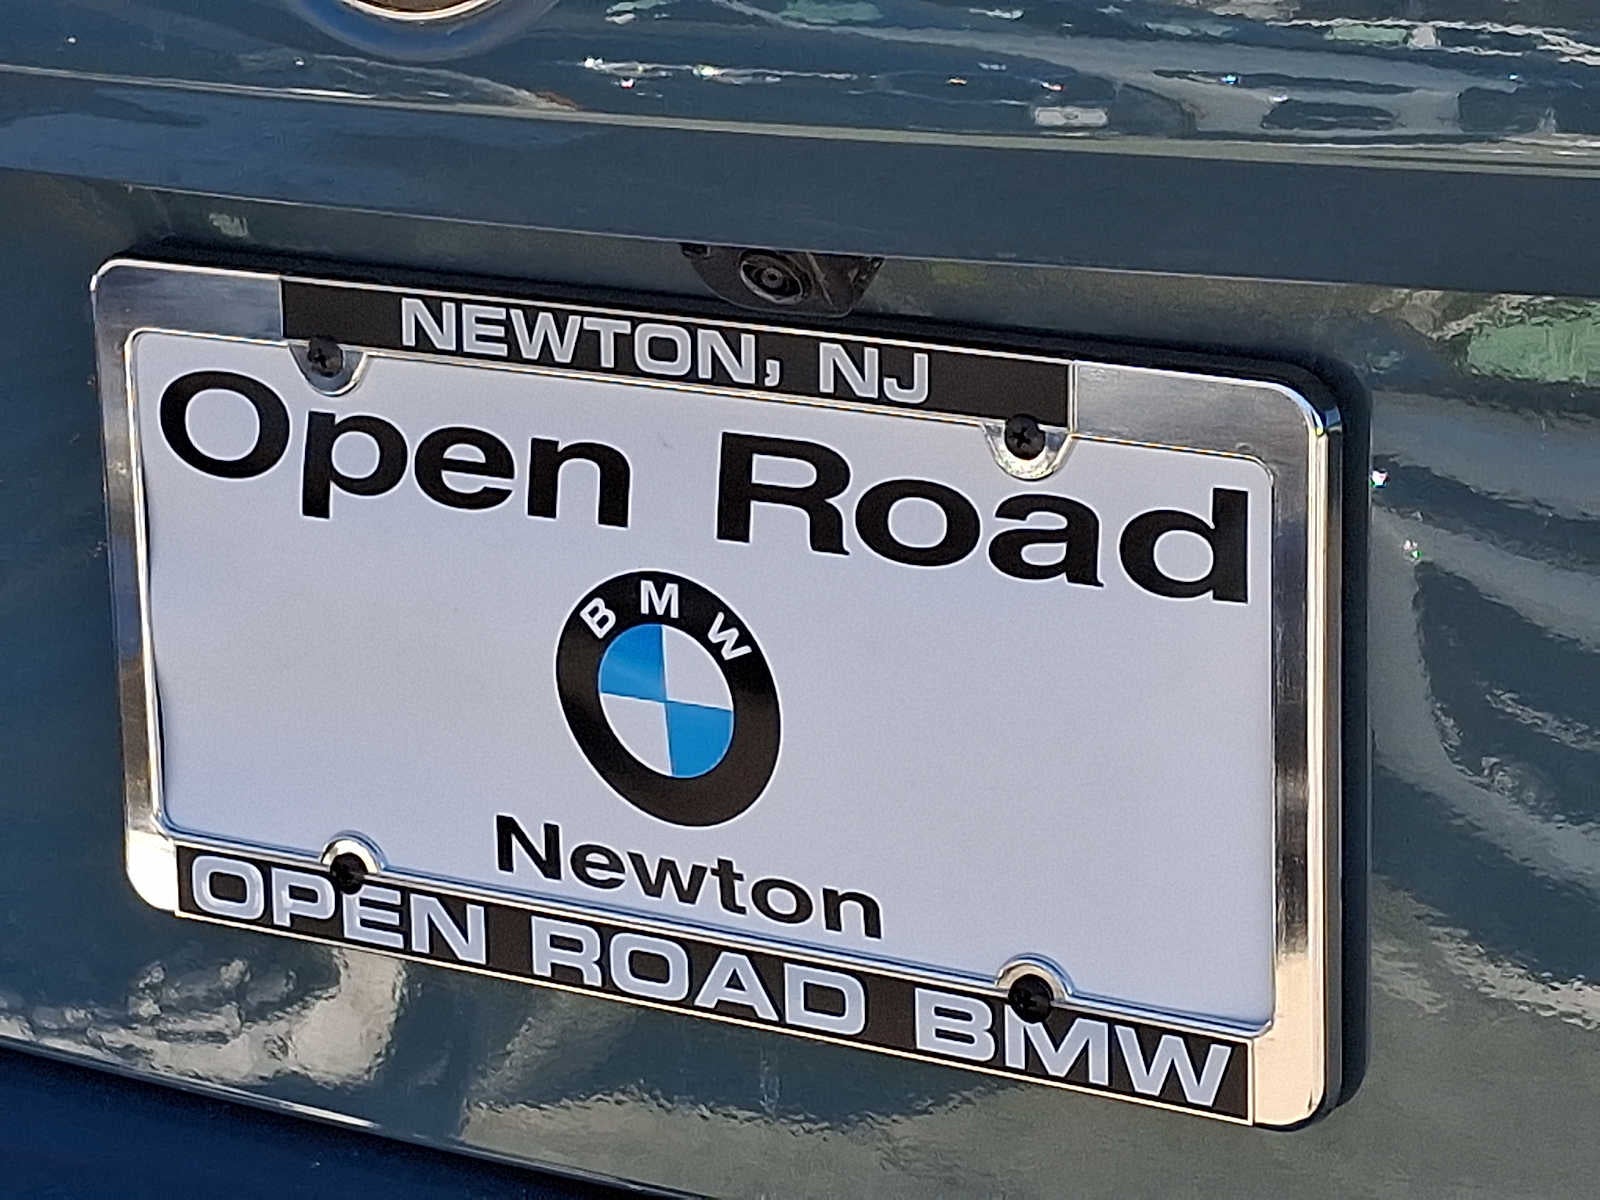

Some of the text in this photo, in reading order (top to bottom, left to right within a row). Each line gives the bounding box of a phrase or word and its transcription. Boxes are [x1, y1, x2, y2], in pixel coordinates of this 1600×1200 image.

[400, 297, 930, 404] NEWTON, NJ
[160, 370, 1249, 603] Open Road
[579, 580, 752, 660] BMW
[497, 814, 881, 938] Newton
[191, 855, 1232, 1107] OPEN ROAD BMW
